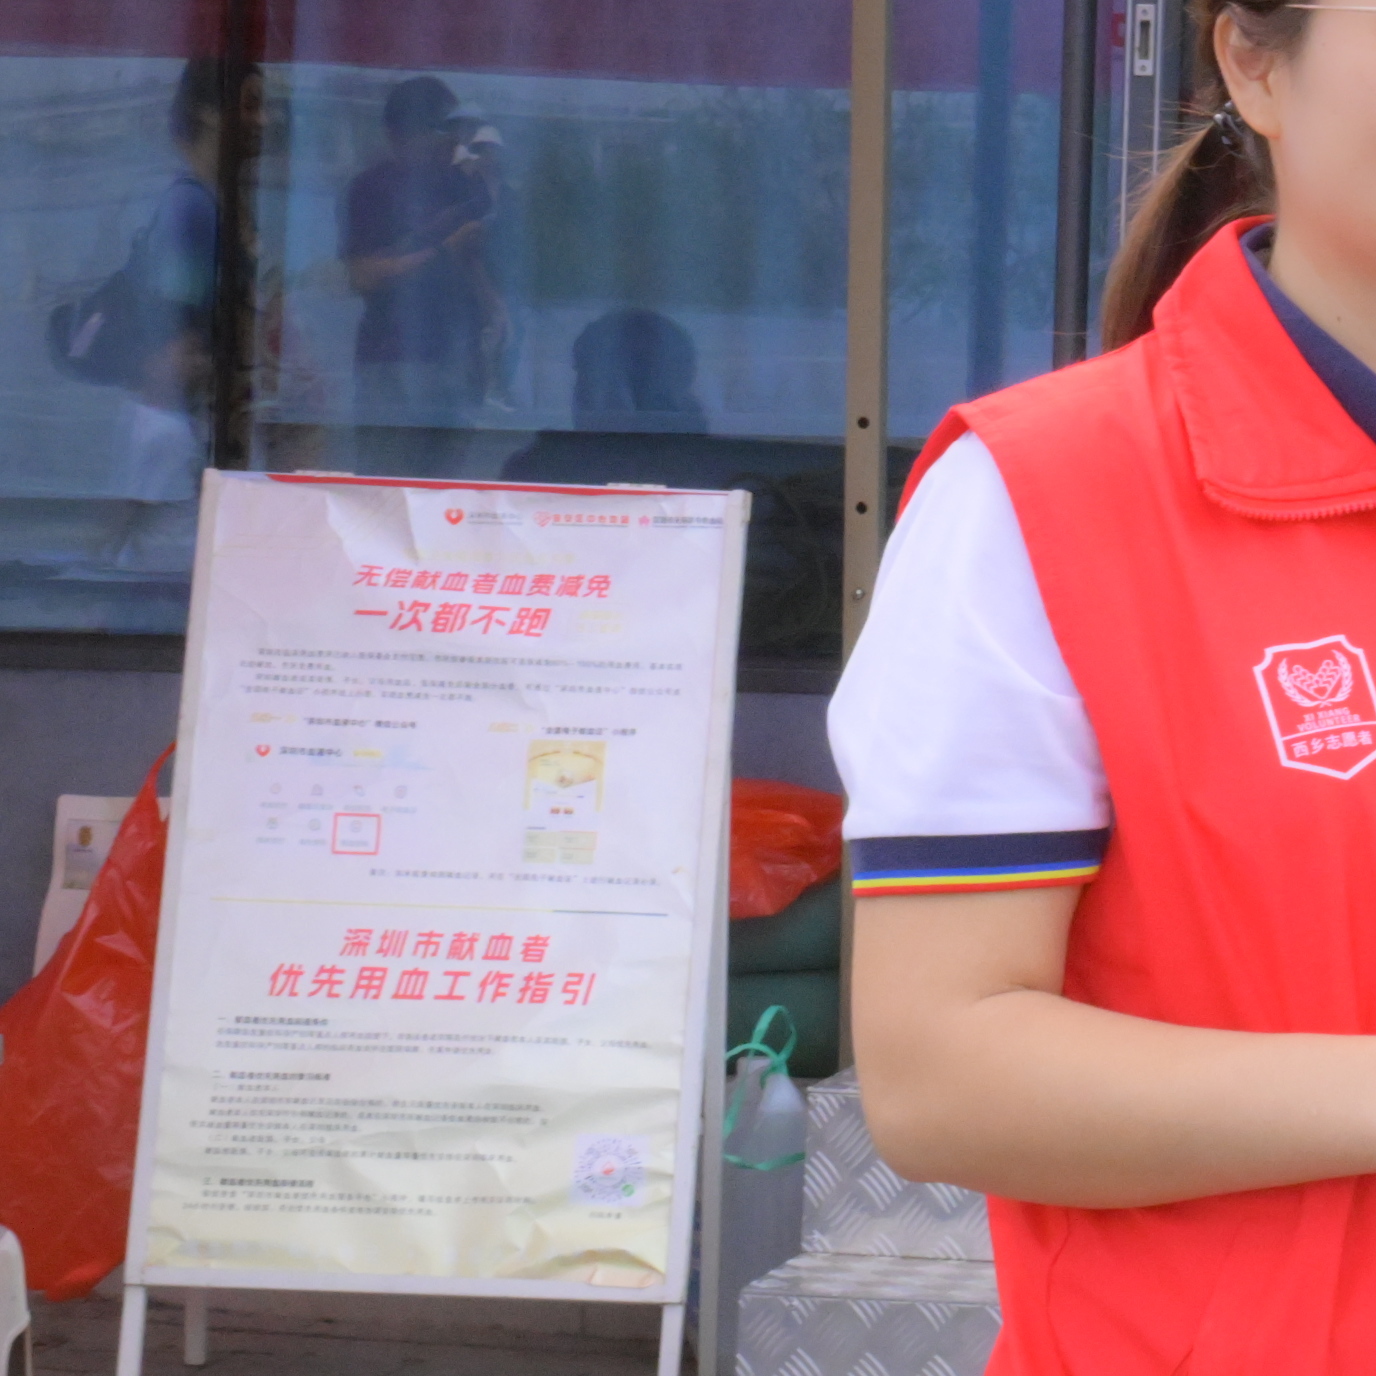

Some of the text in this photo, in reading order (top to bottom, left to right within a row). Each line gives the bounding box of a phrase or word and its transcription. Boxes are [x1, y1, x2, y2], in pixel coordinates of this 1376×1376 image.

[353, 564, 612, 599] 无偿献血者血费减免
[353, 600, 552, 638] 一次都不跑
[1297, 713, 1361, 732] VOLUNTEER
[1291, 730, 1373, 758] 西乡志愿者
[340, 927, 552, 964] 深圳市献血者
[267, 962, 596, 1006] 优先用血工作指引
